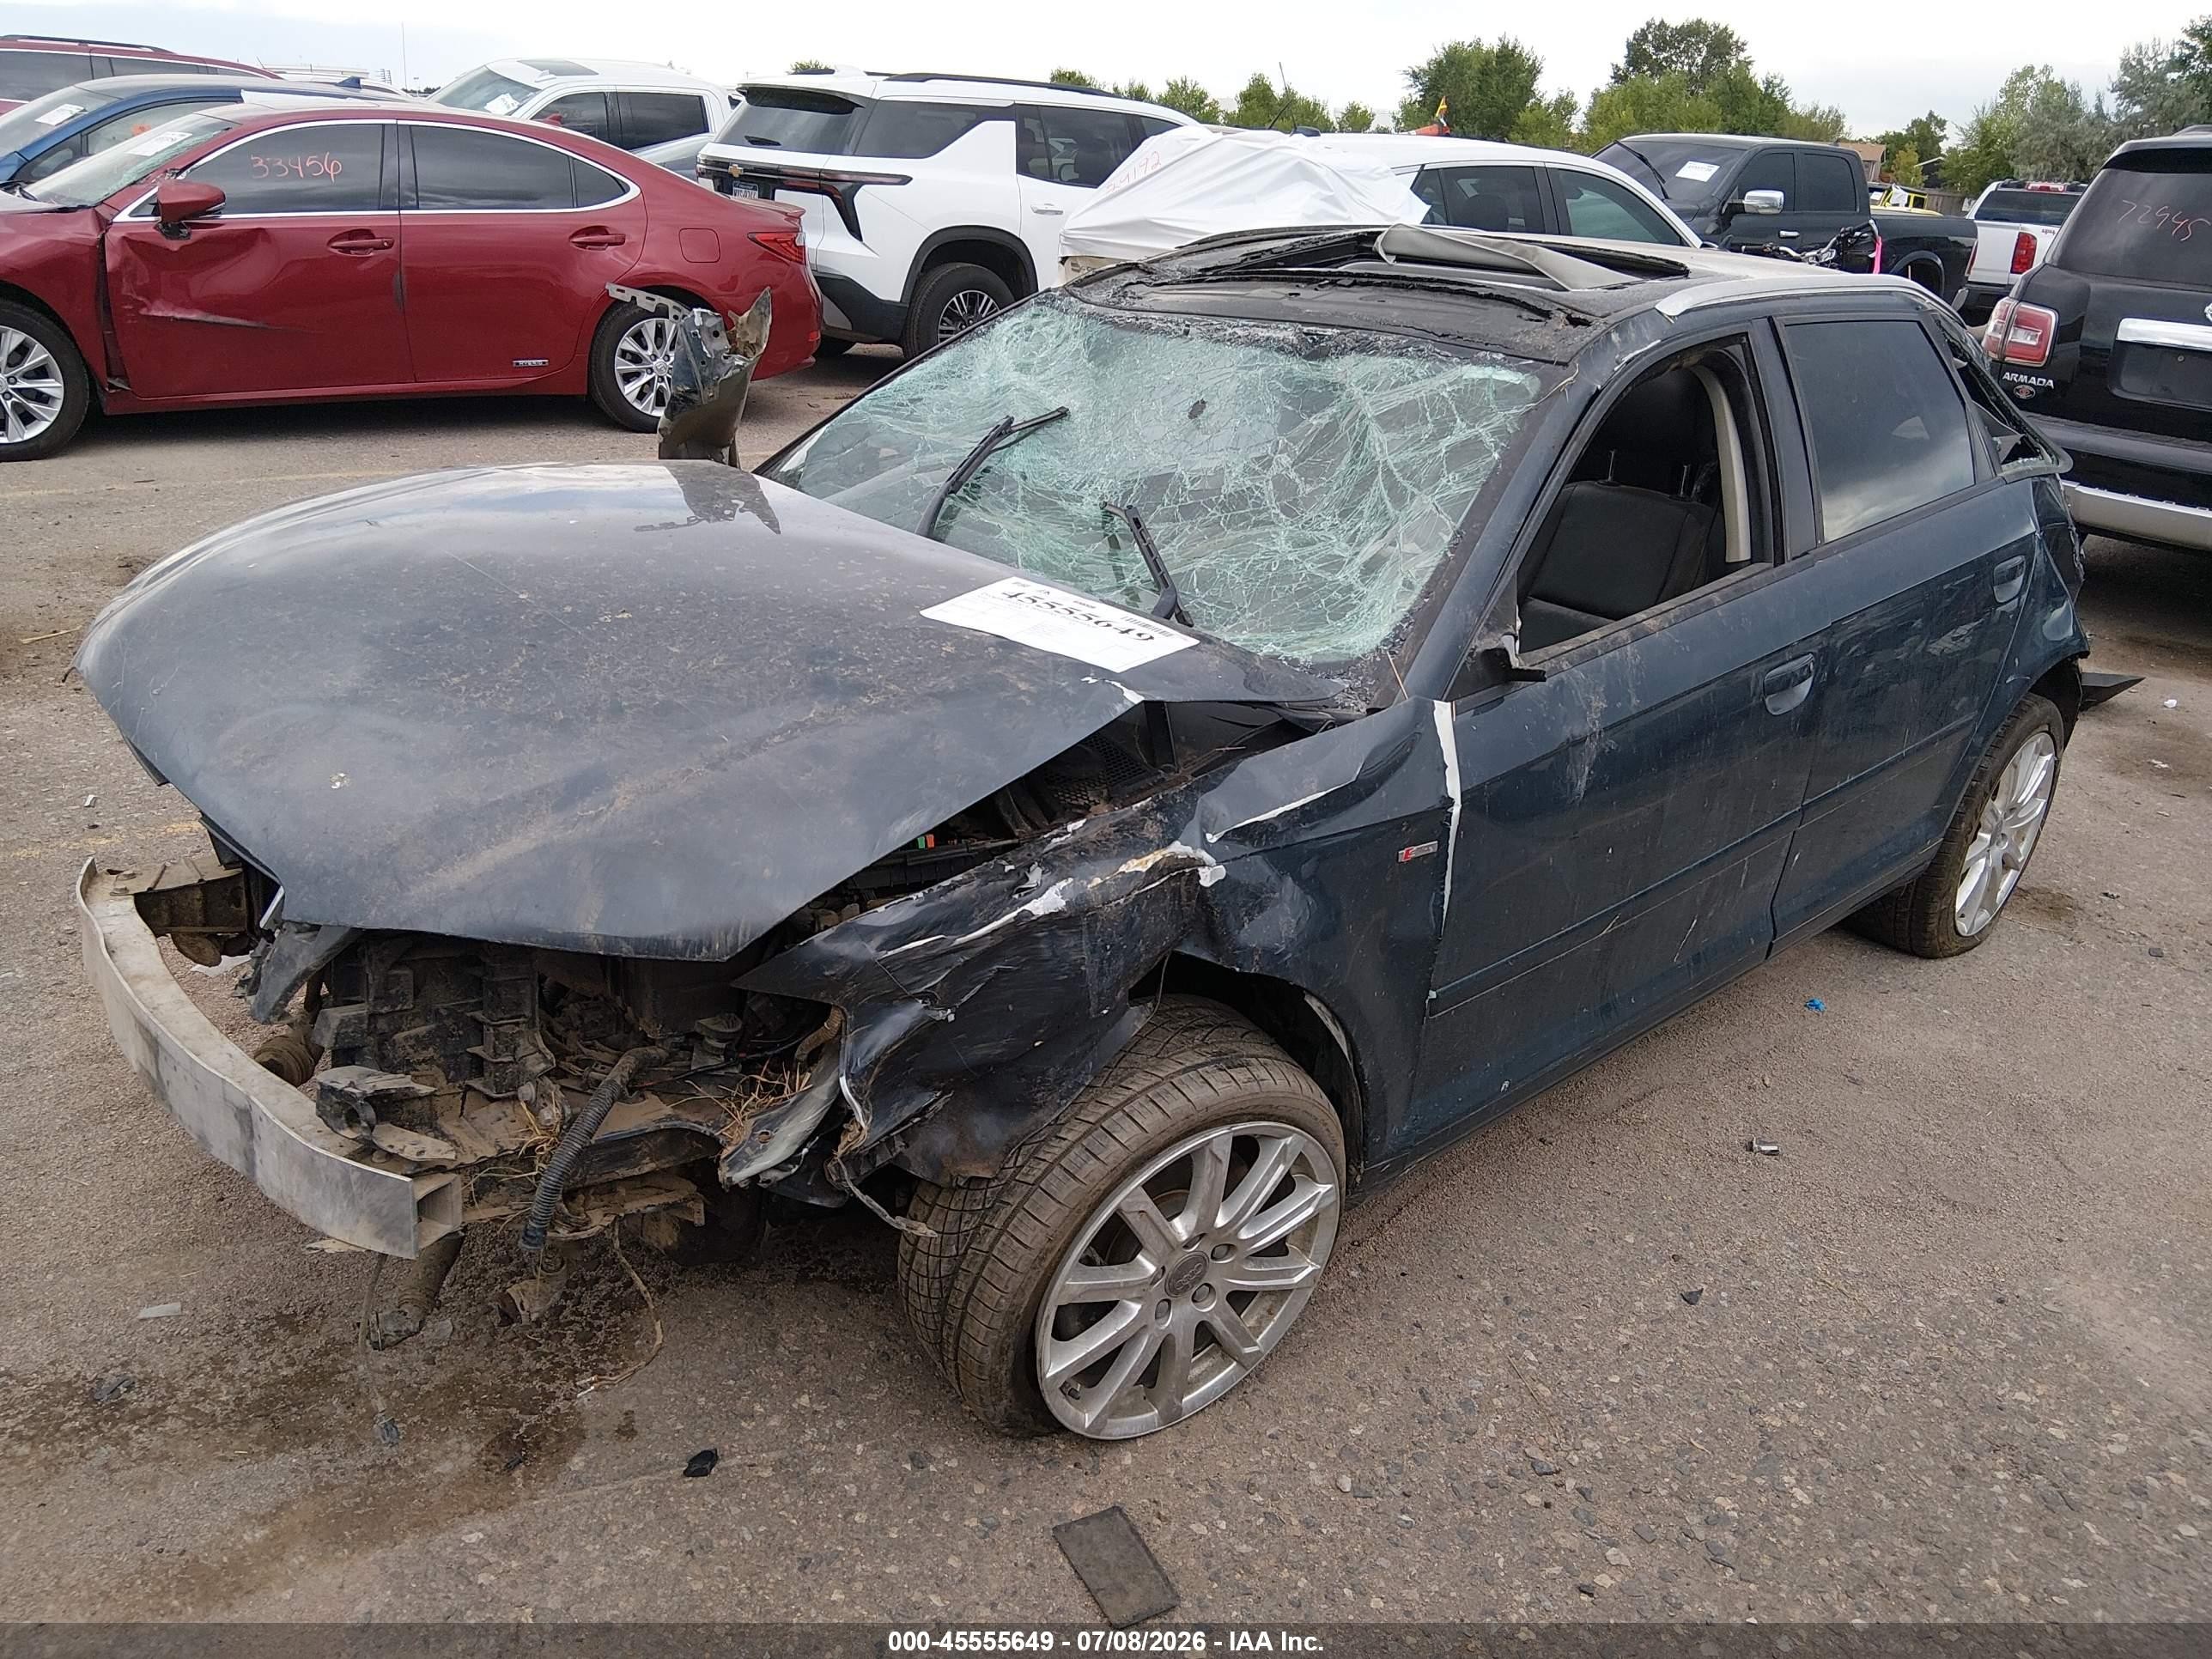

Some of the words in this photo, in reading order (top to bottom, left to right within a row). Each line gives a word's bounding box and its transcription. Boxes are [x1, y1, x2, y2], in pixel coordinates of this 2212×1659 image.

[250, 151, 343, 185] 33456
[2118, 199, 2212, 241] 72945
[2002, 372, 2055, 390] ARMADA
[1001, 591, 1156, 641] 45555649
